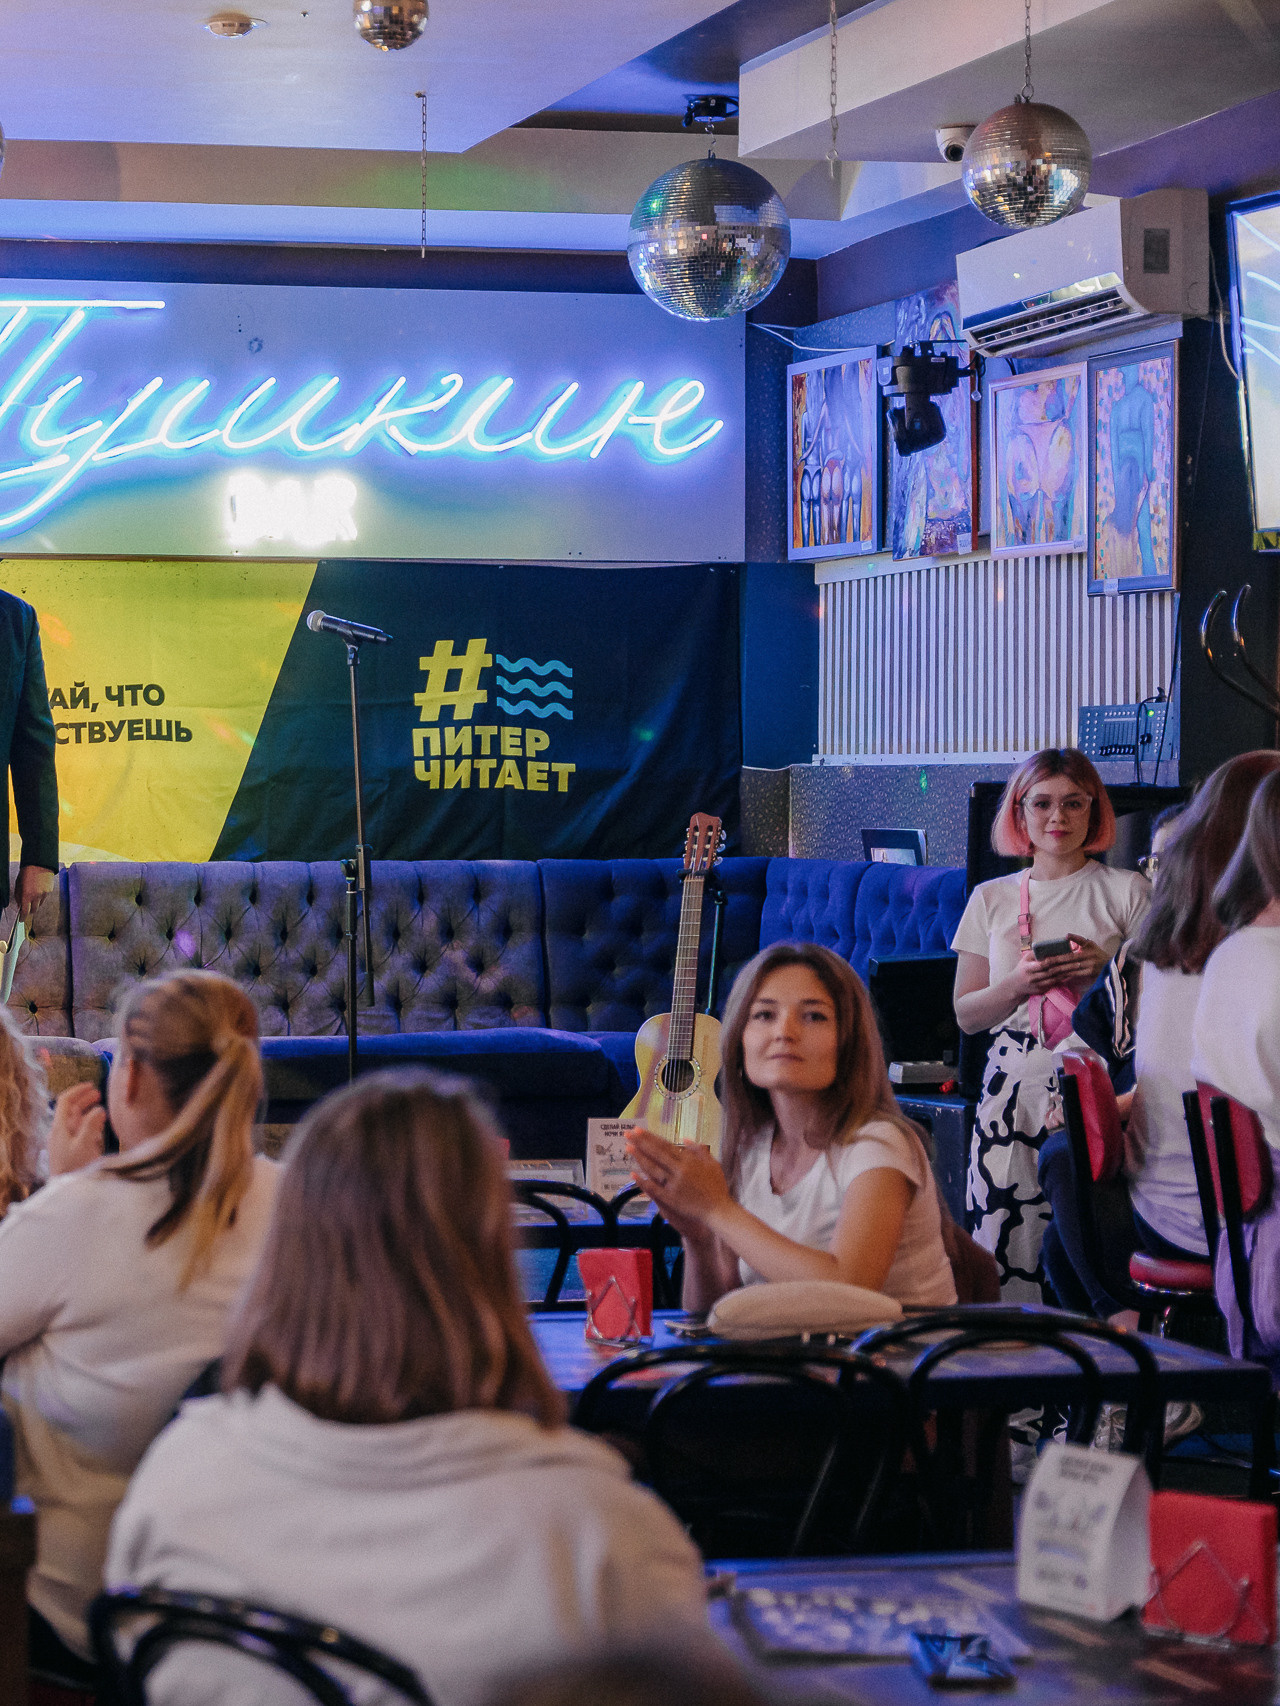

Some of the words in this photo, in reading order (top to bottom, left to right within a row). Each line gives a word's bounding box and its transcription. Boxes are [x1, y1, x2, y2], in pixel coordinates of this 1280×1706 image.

[48, 680, 99, 713] АЙ,
[105, 683, 165, 707] ЧТО
[54, 718, 193, 745] СТВУЕШЬ
[412, 725, 551, 758] ПИТЕР
[414, 758, 577, 793] ЧИТАЕТ
